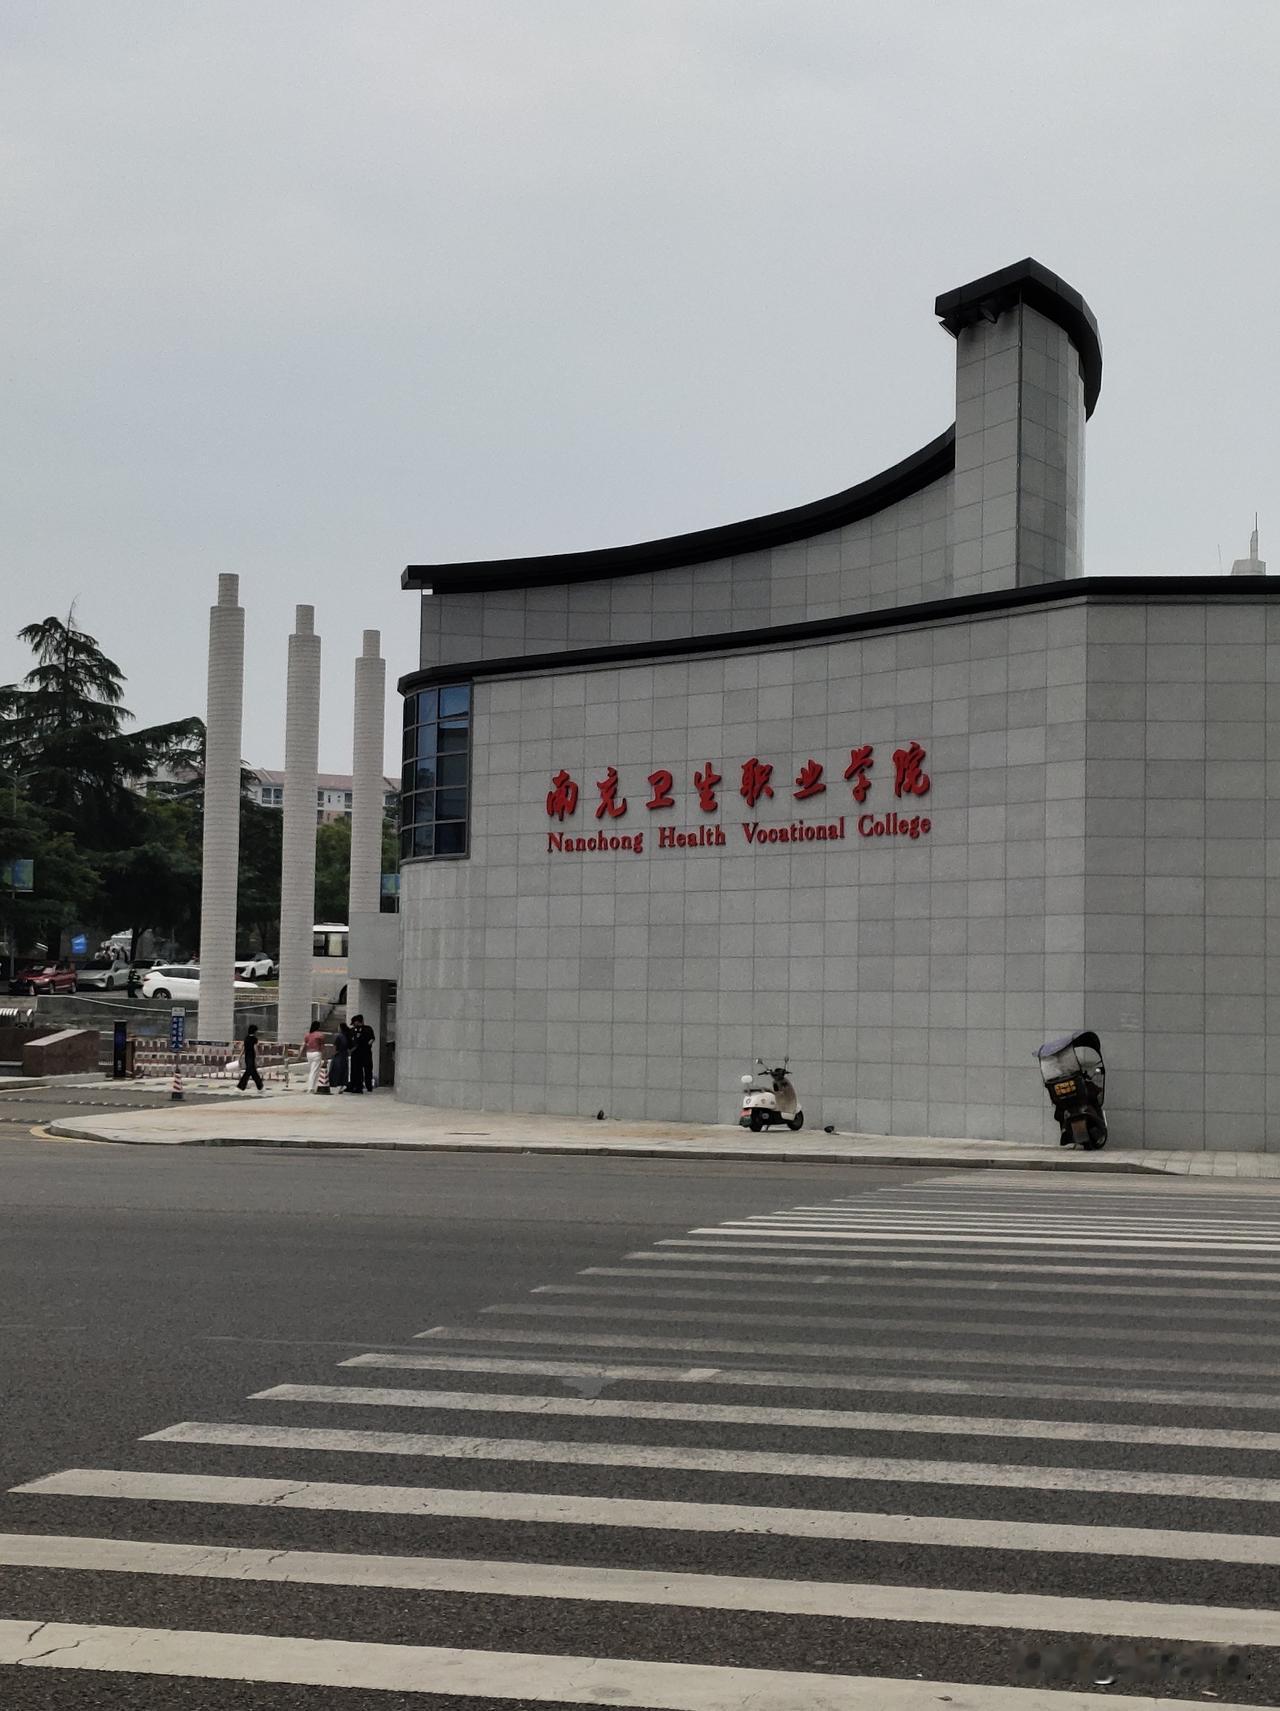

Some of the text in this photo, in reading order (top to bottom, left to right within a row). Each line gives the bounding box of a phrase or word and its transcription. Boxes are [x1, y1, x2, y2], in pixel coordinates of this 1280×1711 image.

[546, 742, 930, 821] 南充卫生职业学院
[547, 812, 931, 854] Nanchong Health Vocational College
